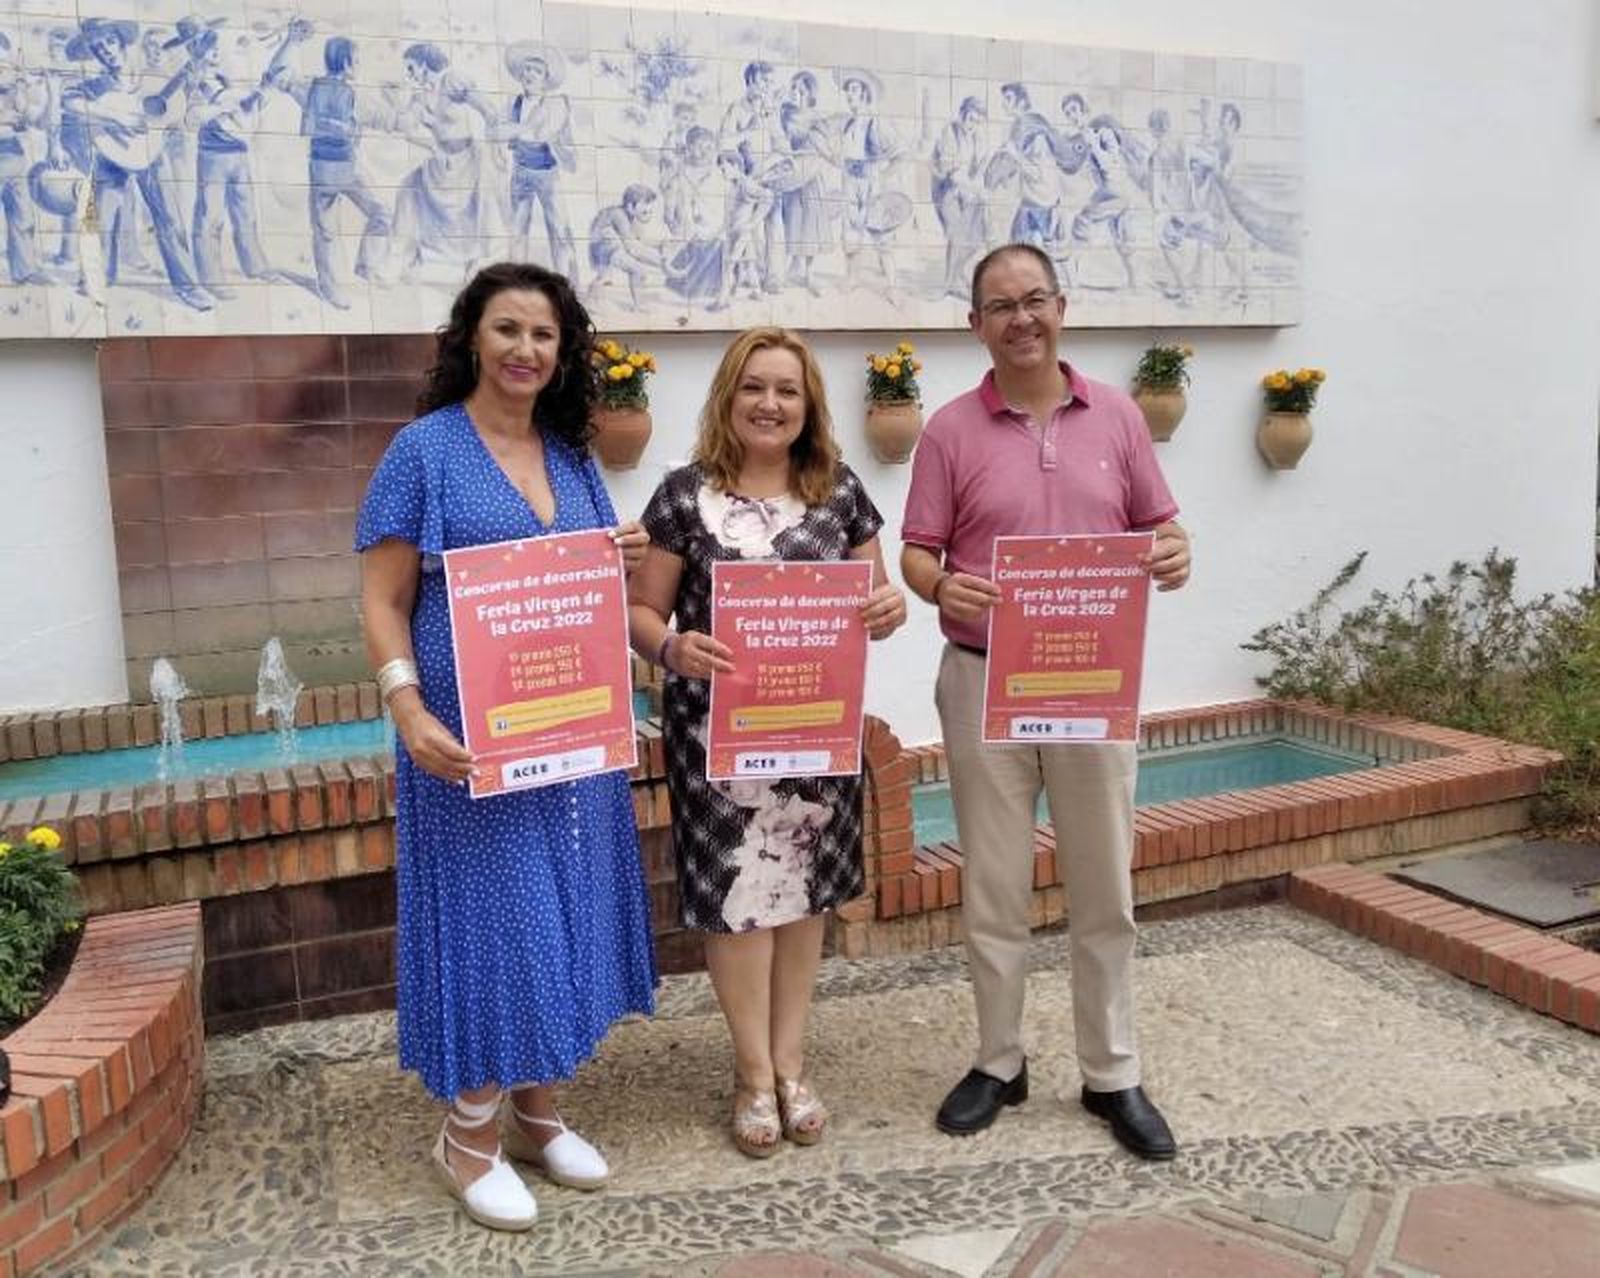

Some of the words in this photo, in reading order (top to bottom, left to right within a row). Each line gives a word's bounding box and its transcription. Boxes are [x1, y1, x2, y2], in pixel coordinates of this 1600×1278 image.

[998, 569, 1057, 580] Concurso
[1059, 566, 1074, 579] de
[455, 579, 520, 598] Concurso
[523, 575, 539, 588] de
[1014, 587, 1053, 602] Feria
[1056, 586, 1107, 603] Virgen
[1109, 585, 1129, 600] de
[476, 602, 521, 621] Feria
[523, 595, 581, 614] Virgen
[585, 592, 603, 606] de
[717, 596, 777, 608] Concurso
[779, 595, 795, 608] de
[1023, 603, 1037, 617] la
[1040, 604, 1075, 617] Cruz
[1077, 602, 1116, 616] 2022
[491, 621, 507, 637] la
[511, 617, 550, 634] Cruz
[553, 611, 593, 628] 2022
[736, 617, 775, 633] Feria
[778, 616, 828, 633] Virgen
[831, 616, 849, 630] de
[746, 634, 761, 648] la
[764, 634, 798, 648] Cruz
[801, 633, 839, 647] 2022
